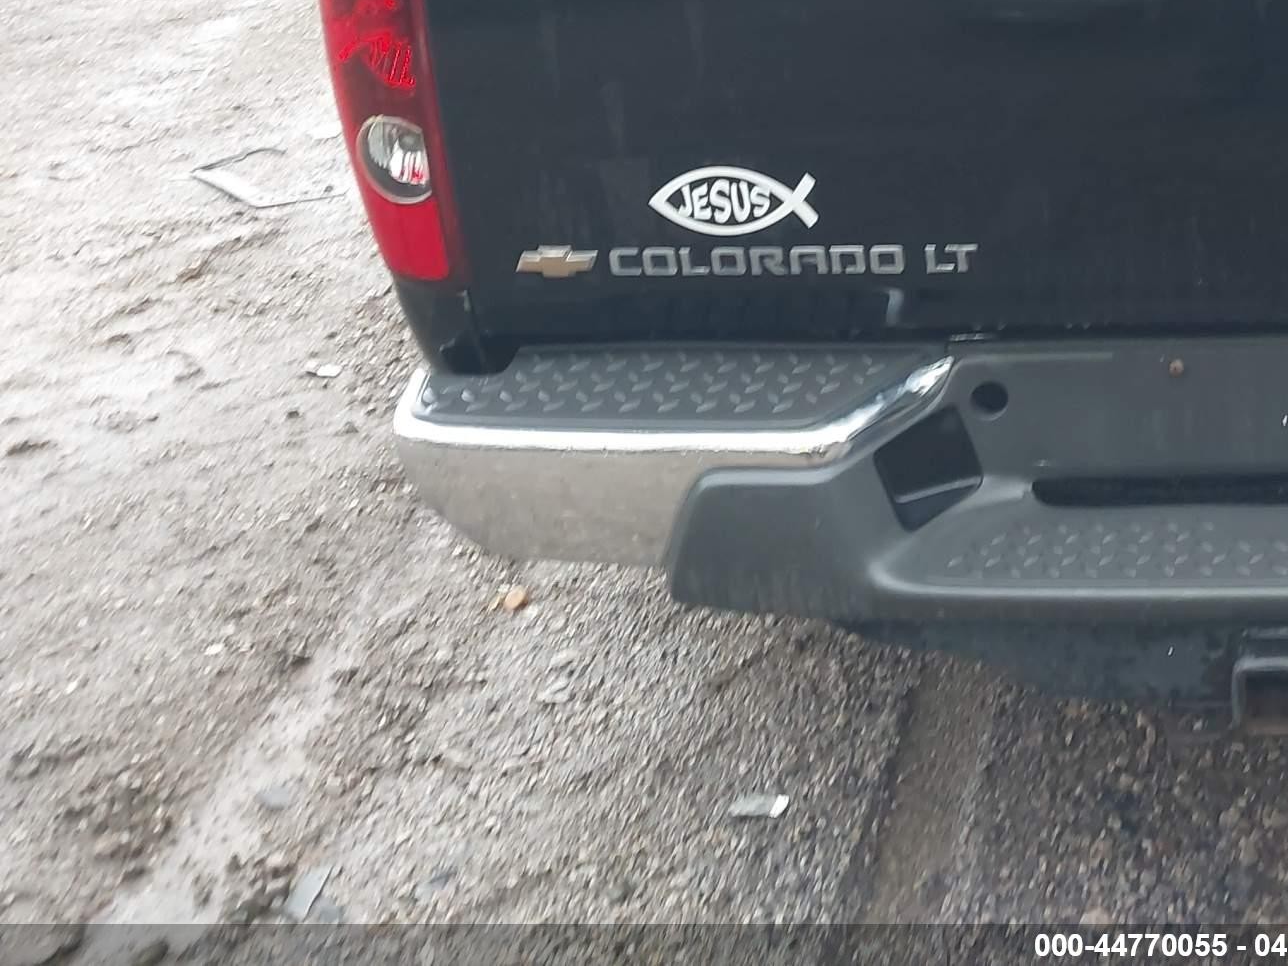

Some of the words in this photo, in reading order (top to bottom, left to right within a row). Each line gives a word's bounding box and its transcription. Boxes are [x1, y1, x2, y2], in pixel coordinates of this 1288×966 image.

[679, 178, 772, 224] JESUS
[609, 245, 905, 277] COLORADO
[925, 243, 980, 274] LT
